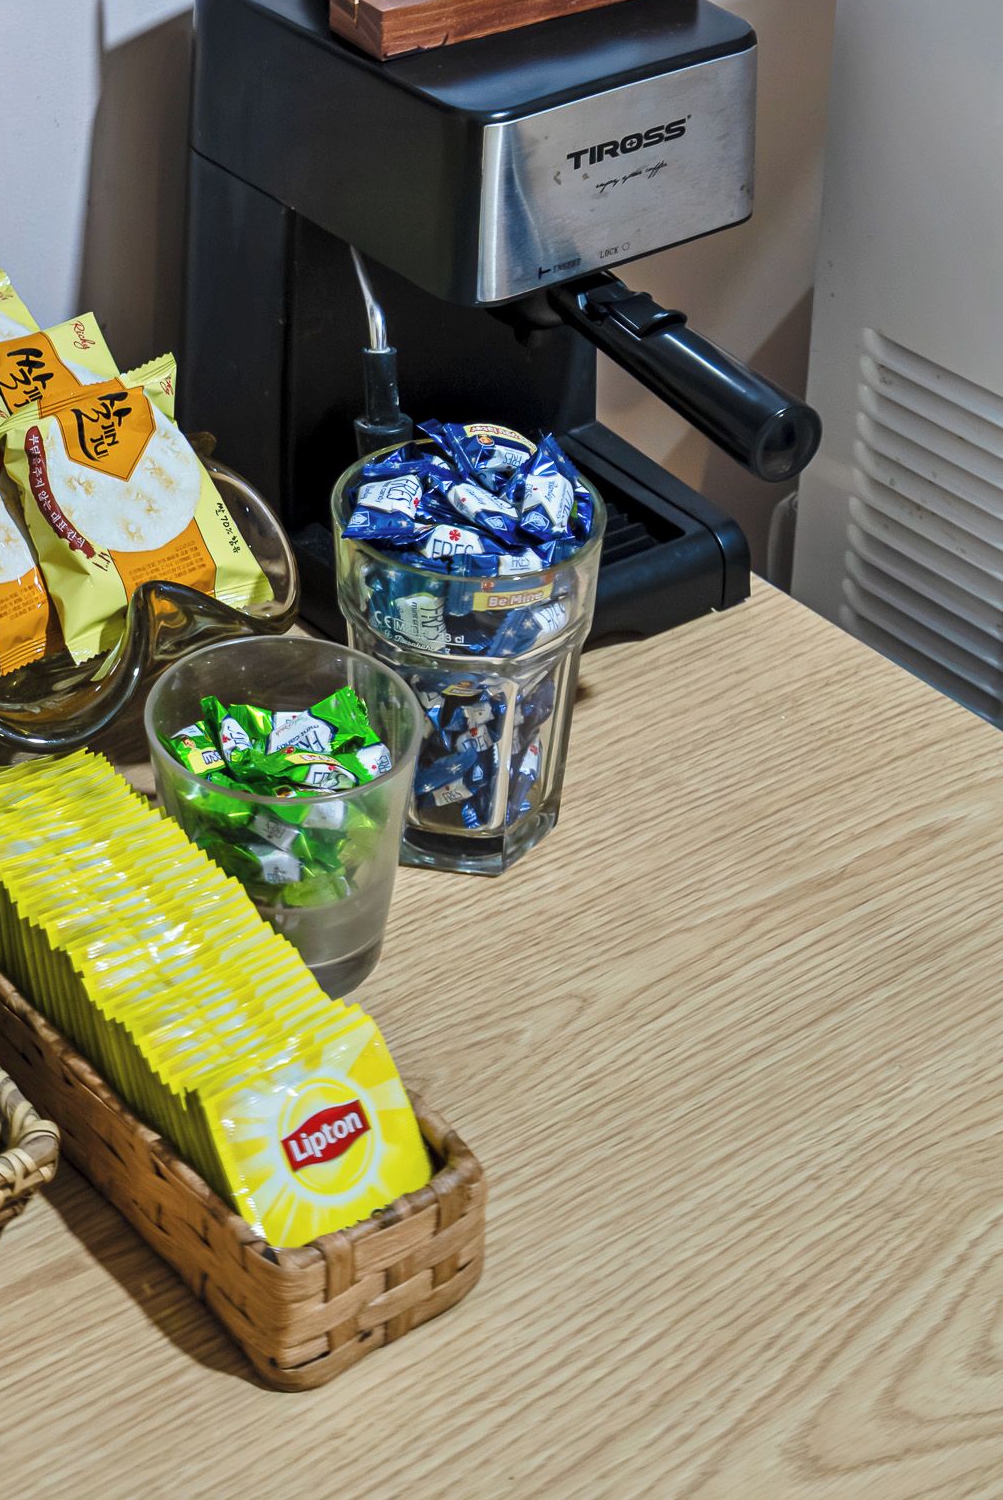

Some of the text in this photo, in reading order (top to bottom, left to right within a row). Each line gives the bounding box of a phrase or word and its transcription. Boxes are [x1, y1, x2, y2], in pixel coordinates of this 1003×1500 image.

[566, 117, 687, 171] TIROSS
[599, 245, 620, 259] LOCK
[101, 422, 120, 446] JIN
[487, 592, 508, 608] Be
[288, 1111, 364, 1162] Lipton
